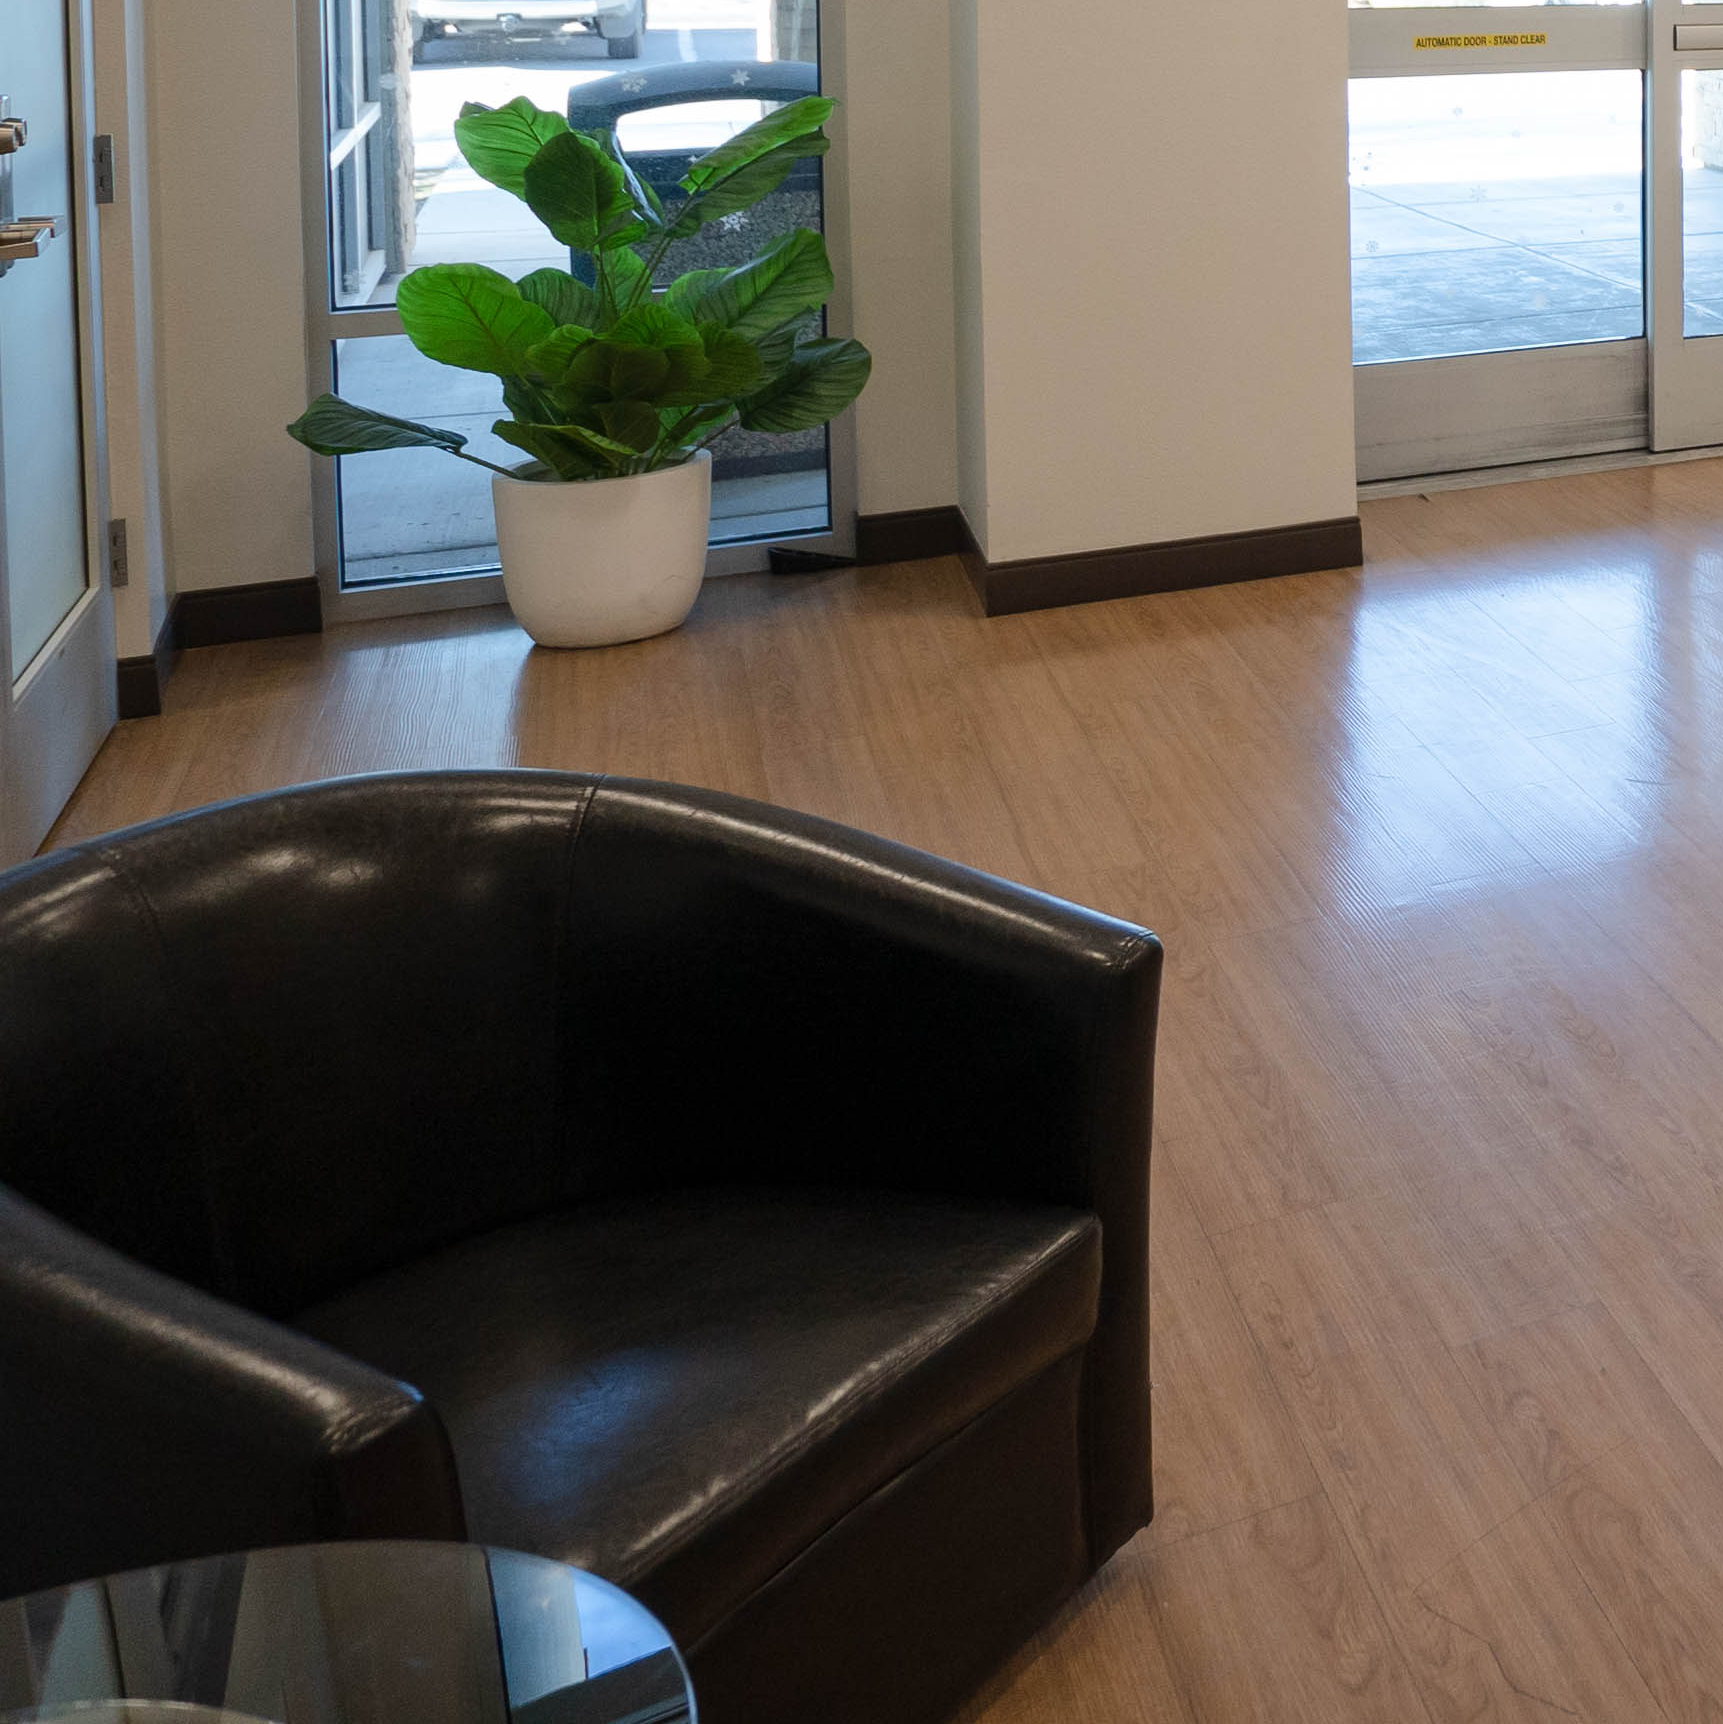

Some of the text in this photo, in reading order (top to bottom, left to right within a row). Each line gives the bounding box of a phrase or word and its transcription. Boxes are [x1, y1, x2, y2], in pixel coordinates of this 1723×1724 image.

[1416, 37, 1462, 48] AUTOMATIC
[1463, 36, 1487, 46] DOOR
[1493, 35, 1519, 45] STAND
[1520, 34, 1546, 45] CLEAR
